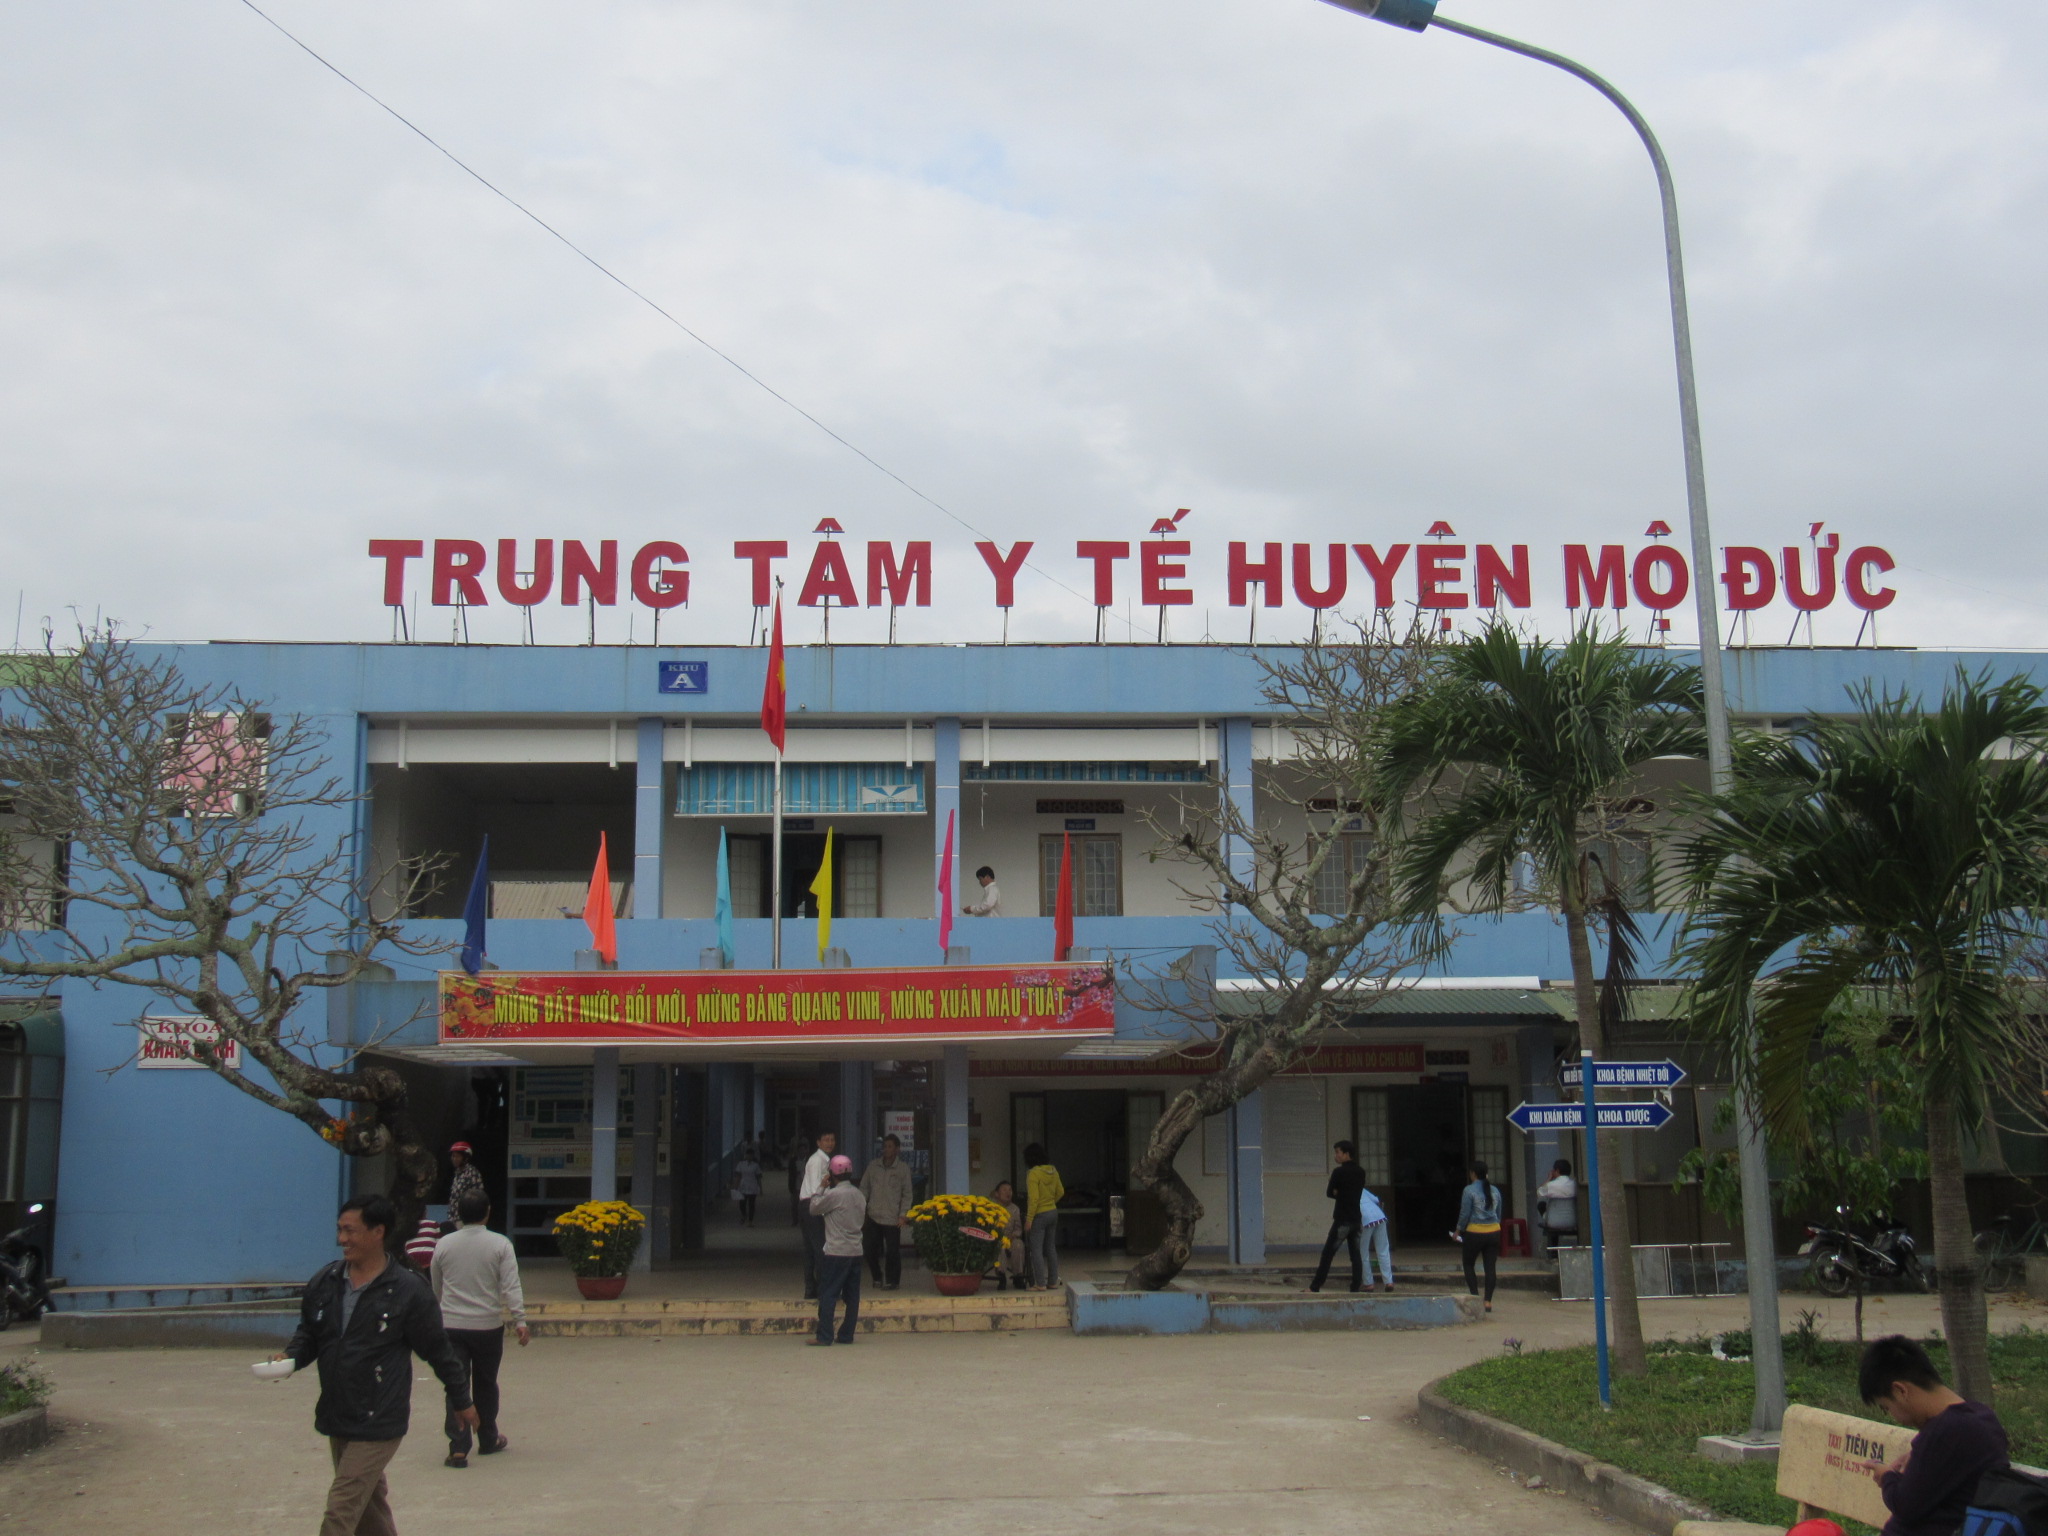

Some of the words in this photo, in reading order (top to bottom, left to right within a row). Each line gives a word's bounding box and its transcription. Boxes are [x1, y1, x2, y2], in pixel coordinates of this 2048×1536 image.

[370, 539, 690, 609] TRUNG
[735, 518, 932, 606] TÂM
[975, 541, 1034, 606] Y
[1077, 508, 1193, 606] TẾ
[1228, 520, 1531, 630] HUYỆN
[1562, 520, 1689, 630] MỘ
[1720, 521, 1897, 610] ĐỨC
[668, 664, 700, 672] KHU
[668, 673, 698, 689] A
[494, 989, 539, 1023] MỪNG
[544, 986, 575, 1023] ĐẤT
[580, 989, 620, 1024] NƯỚC
[625, 983, 652, 1024] ĐỔI
[656, 988, 691, 1028] MỚI,
[697, 987, 740, 1023] MỪNG
[746, 984, 787, 1023] ĐẢNG
[792, 991, 841, 1026] QUANG
[846, 991, 885, 1025] VINH,
[890, 984, 934, 1020] MỪNG
[940, 983, 981, 1019] XUÂN
[986, 982, 1021, 1024] MẬU
[1026, 977, 1065, 1017] TUẤT
[157, 1022, 223, 1034] KHOA
[1596, 1069, 1616, 1082] KHOA
[1616, 1066, 1635, 1084] BỆNH
[1636, 1066, 1656, 1084] NHIỆT
[1529, 1111, 1543, 1124] KHU
[1543, 1109, 1563, 1124] KHÁM
[1563, 1107, 1582, 1126] BỆNH
[1597, 1110, 1623, 1123] KHOA
[1625, 1108, 1650, 1125] DƯỢC
[1828, 1433, 1842, 1450] TAXI
[1845, 1433, 1868, 1458] TIÊN
[1870, 1441, 1884, 1462] SA
